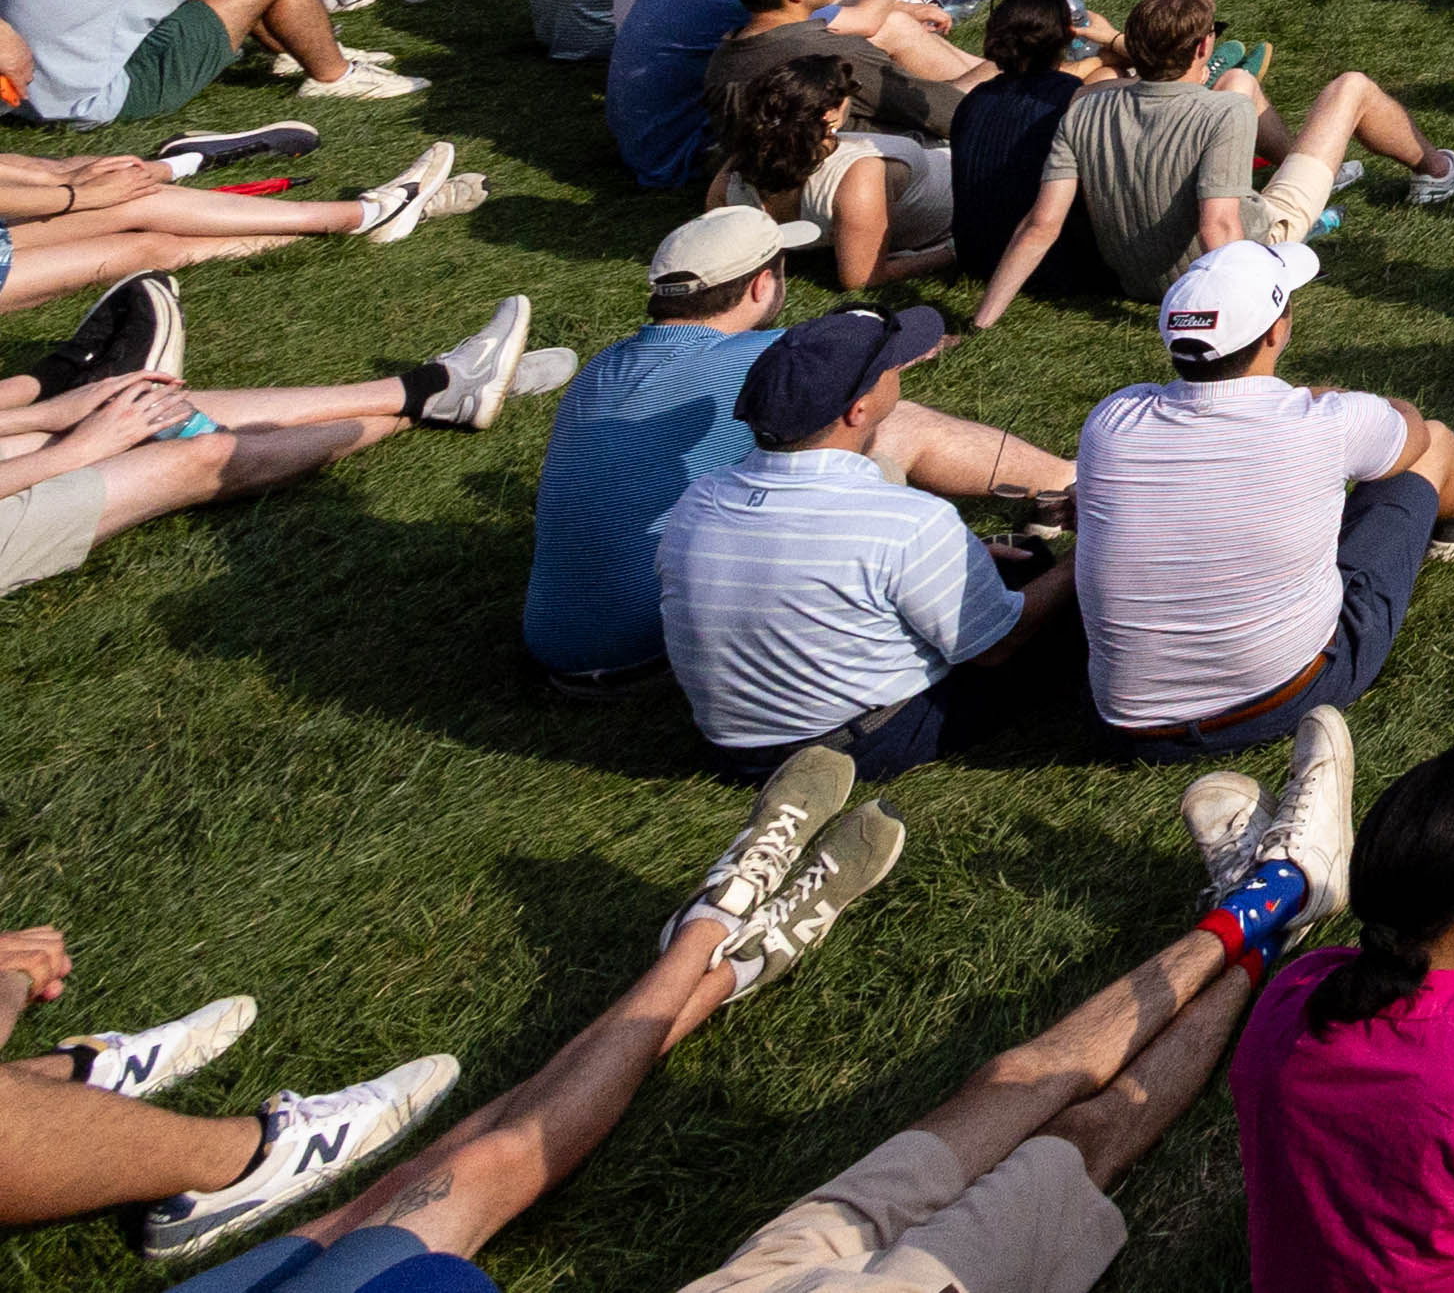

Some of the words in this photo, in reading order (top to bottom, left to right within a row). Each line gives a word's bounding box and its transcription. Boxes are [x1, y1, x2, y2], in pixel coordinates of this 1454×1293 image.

[1168, 313, 1215, 329] Titleist
[745, 489, 769, 508] FJ
[111, 1042, 163, 1094] N
[292, 1120, 351, 1178] N
